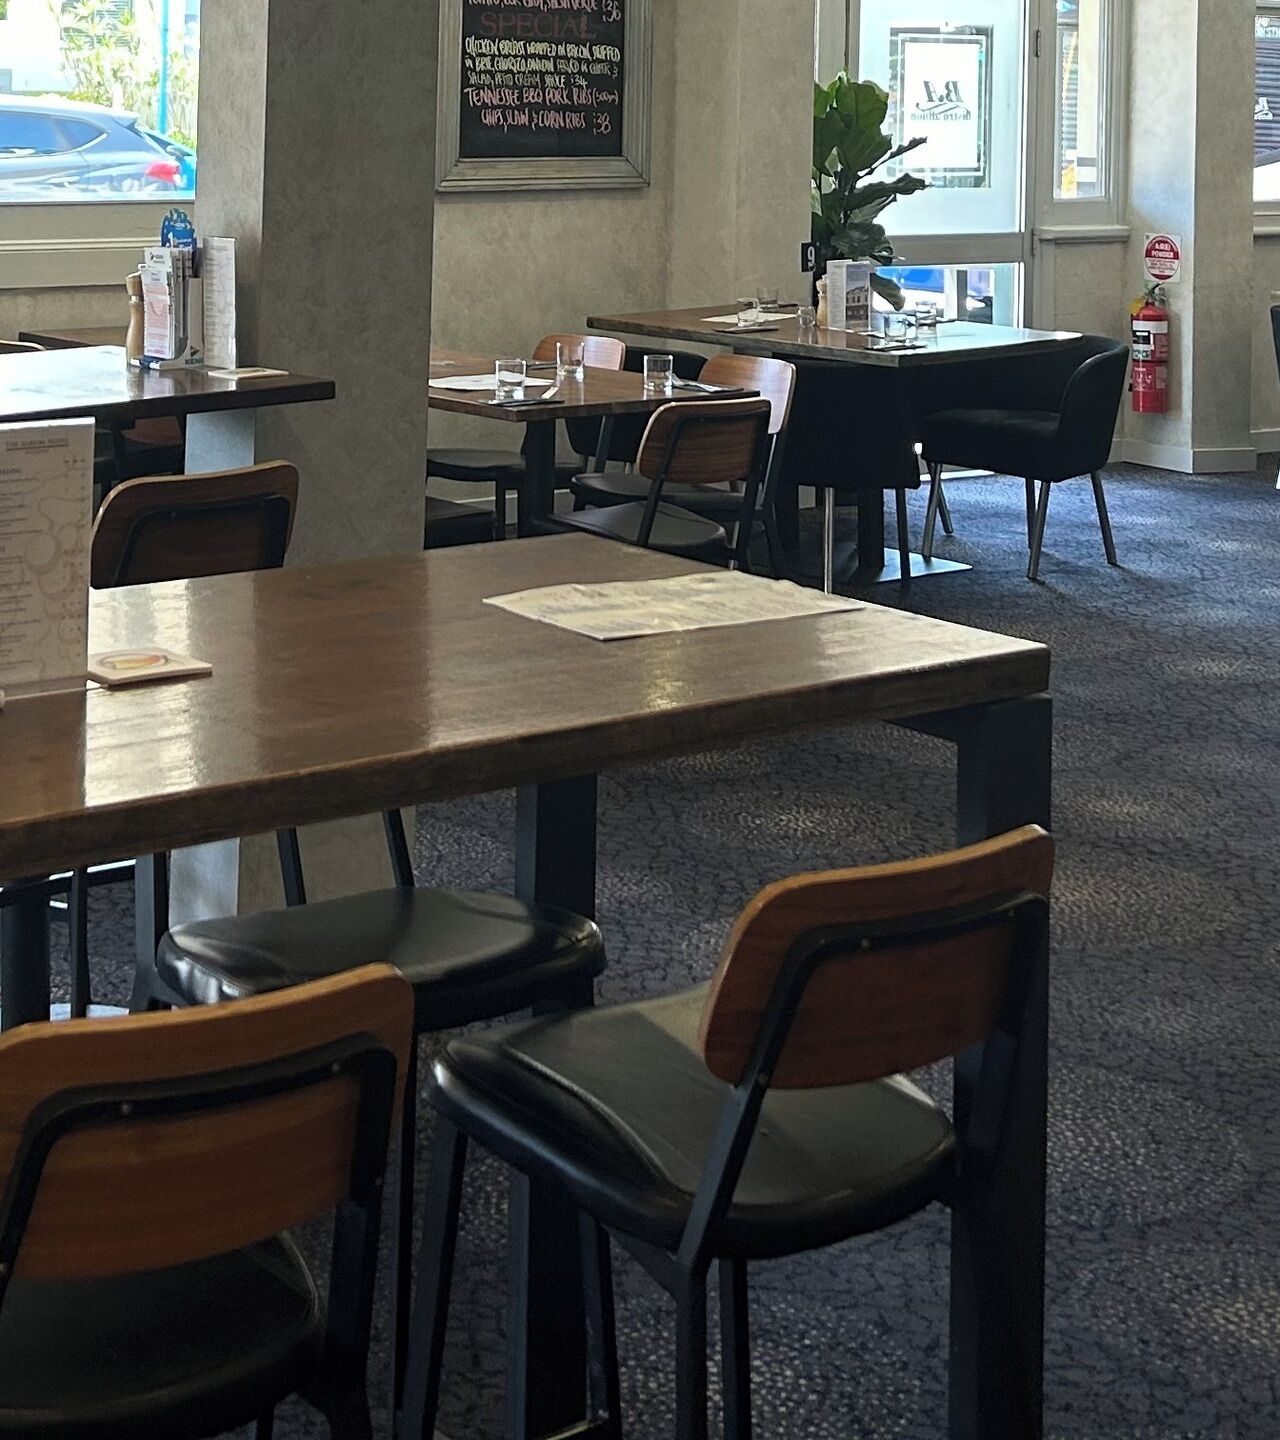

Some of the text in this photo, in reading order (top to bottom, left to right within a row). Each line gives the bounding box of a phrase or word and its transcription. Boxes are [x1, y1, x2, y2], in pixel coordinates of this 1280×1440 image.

[523, 89, 543, 105] BBQ
[545, 89, 570, 106] PORK
[538, 110, 564, 129] CORN
[807, 246, 815, 266] 9
